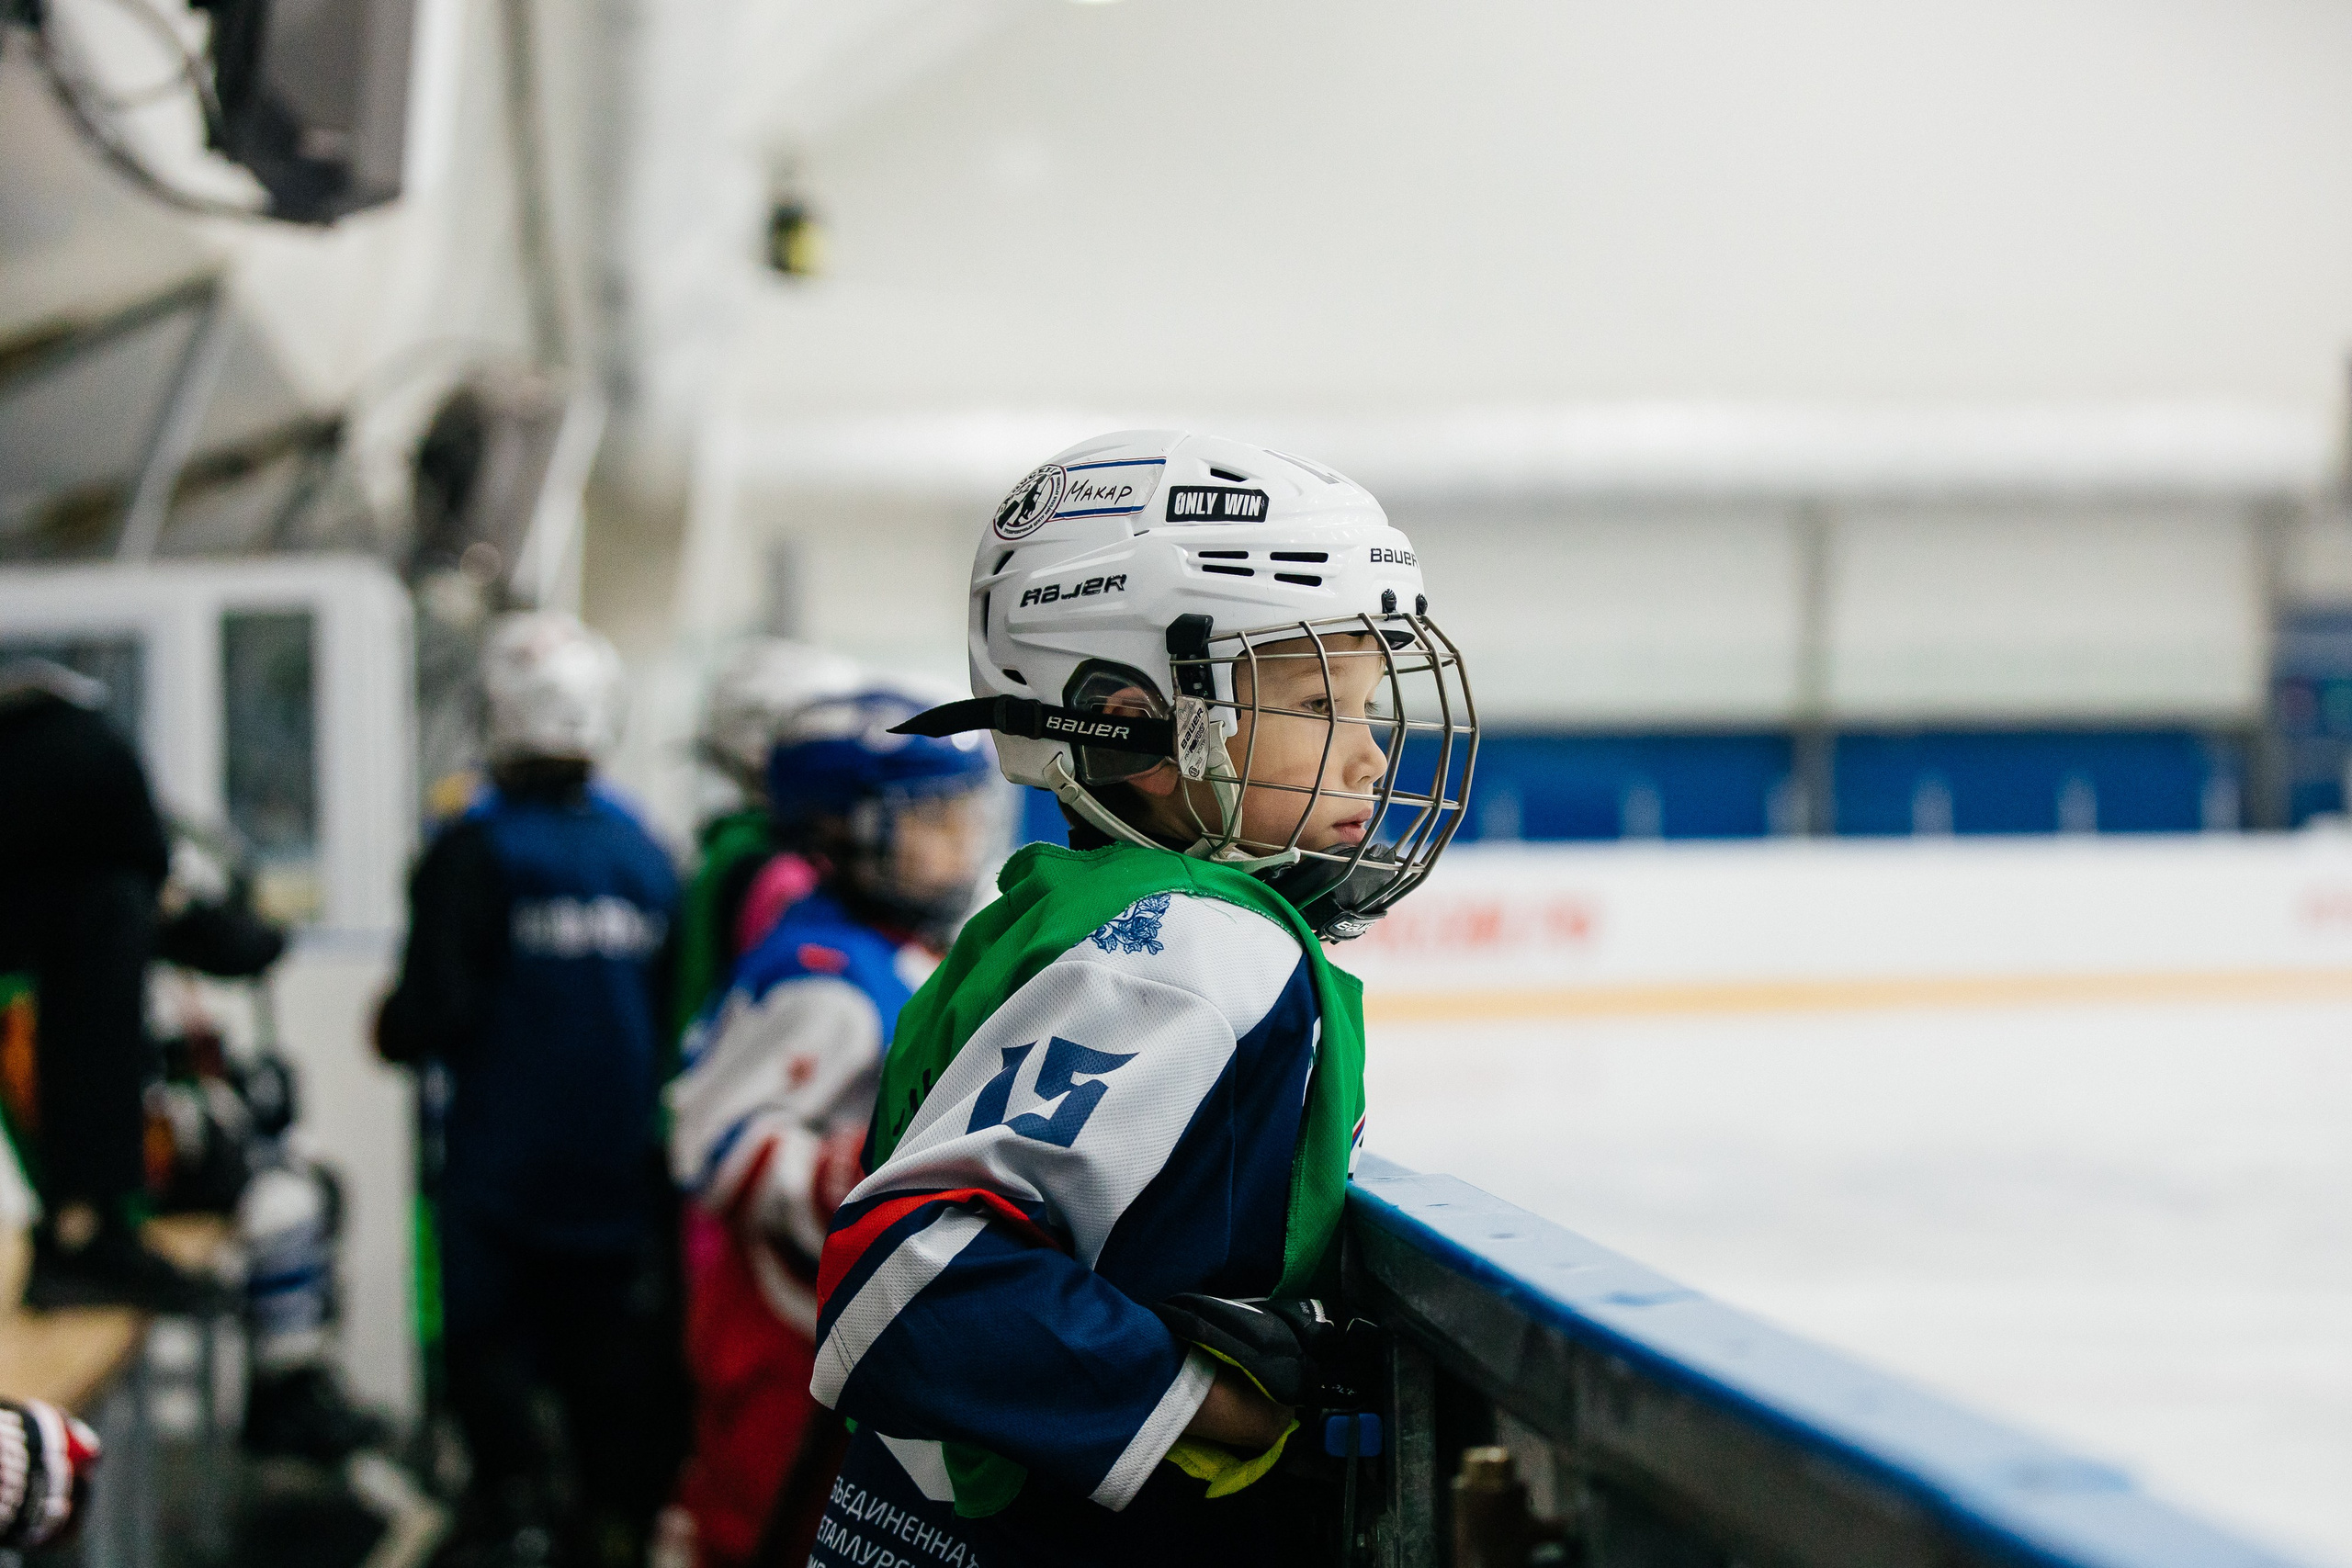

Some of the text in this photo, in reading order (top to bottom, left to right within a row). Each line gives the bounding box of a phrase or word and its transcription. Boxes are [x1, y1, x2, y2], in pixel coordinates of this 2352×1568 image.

[1173, 491, 1261, 517] ONLY WIN
[1046, 715, 1131, 740] BAUER
[1181, 707, 1204, 750] BAUER
[965, 1035, 1140, 1148] 15
